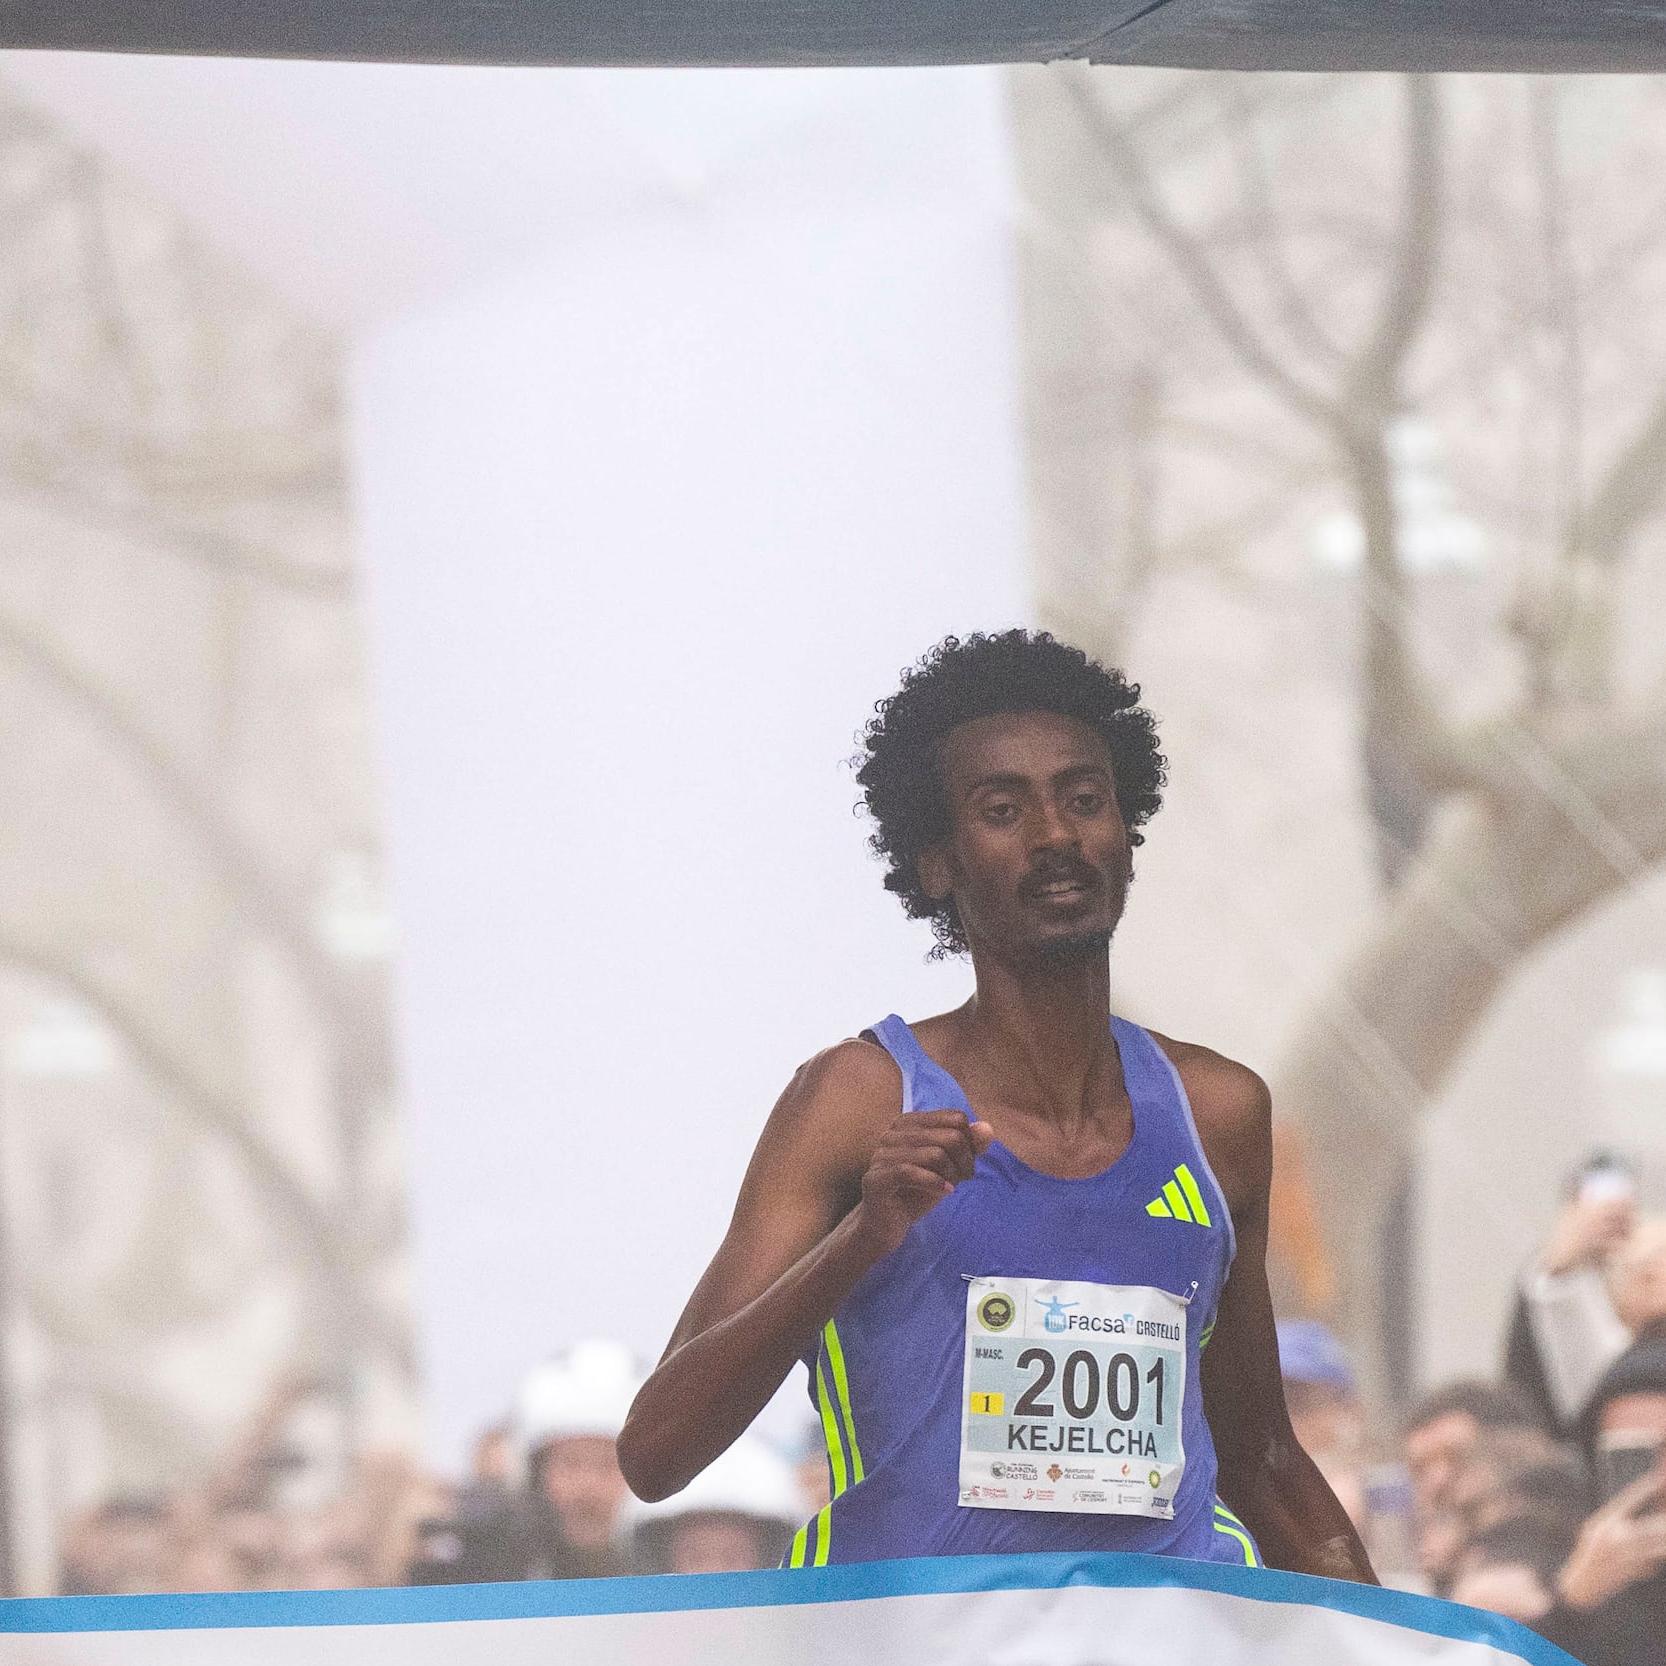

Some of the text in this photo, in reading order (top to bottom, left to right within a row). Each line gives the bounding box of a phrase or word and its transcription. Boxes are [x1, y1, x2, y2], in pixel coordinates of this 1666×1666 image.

[1136, 1320, 1180, 1341] CASTELLÓ
[1013, 1348, 1164, 1425] 2001
[984, 1395, 991, 1413] 1
[1007, 1424, 1158, 1458] KEJELCHA
